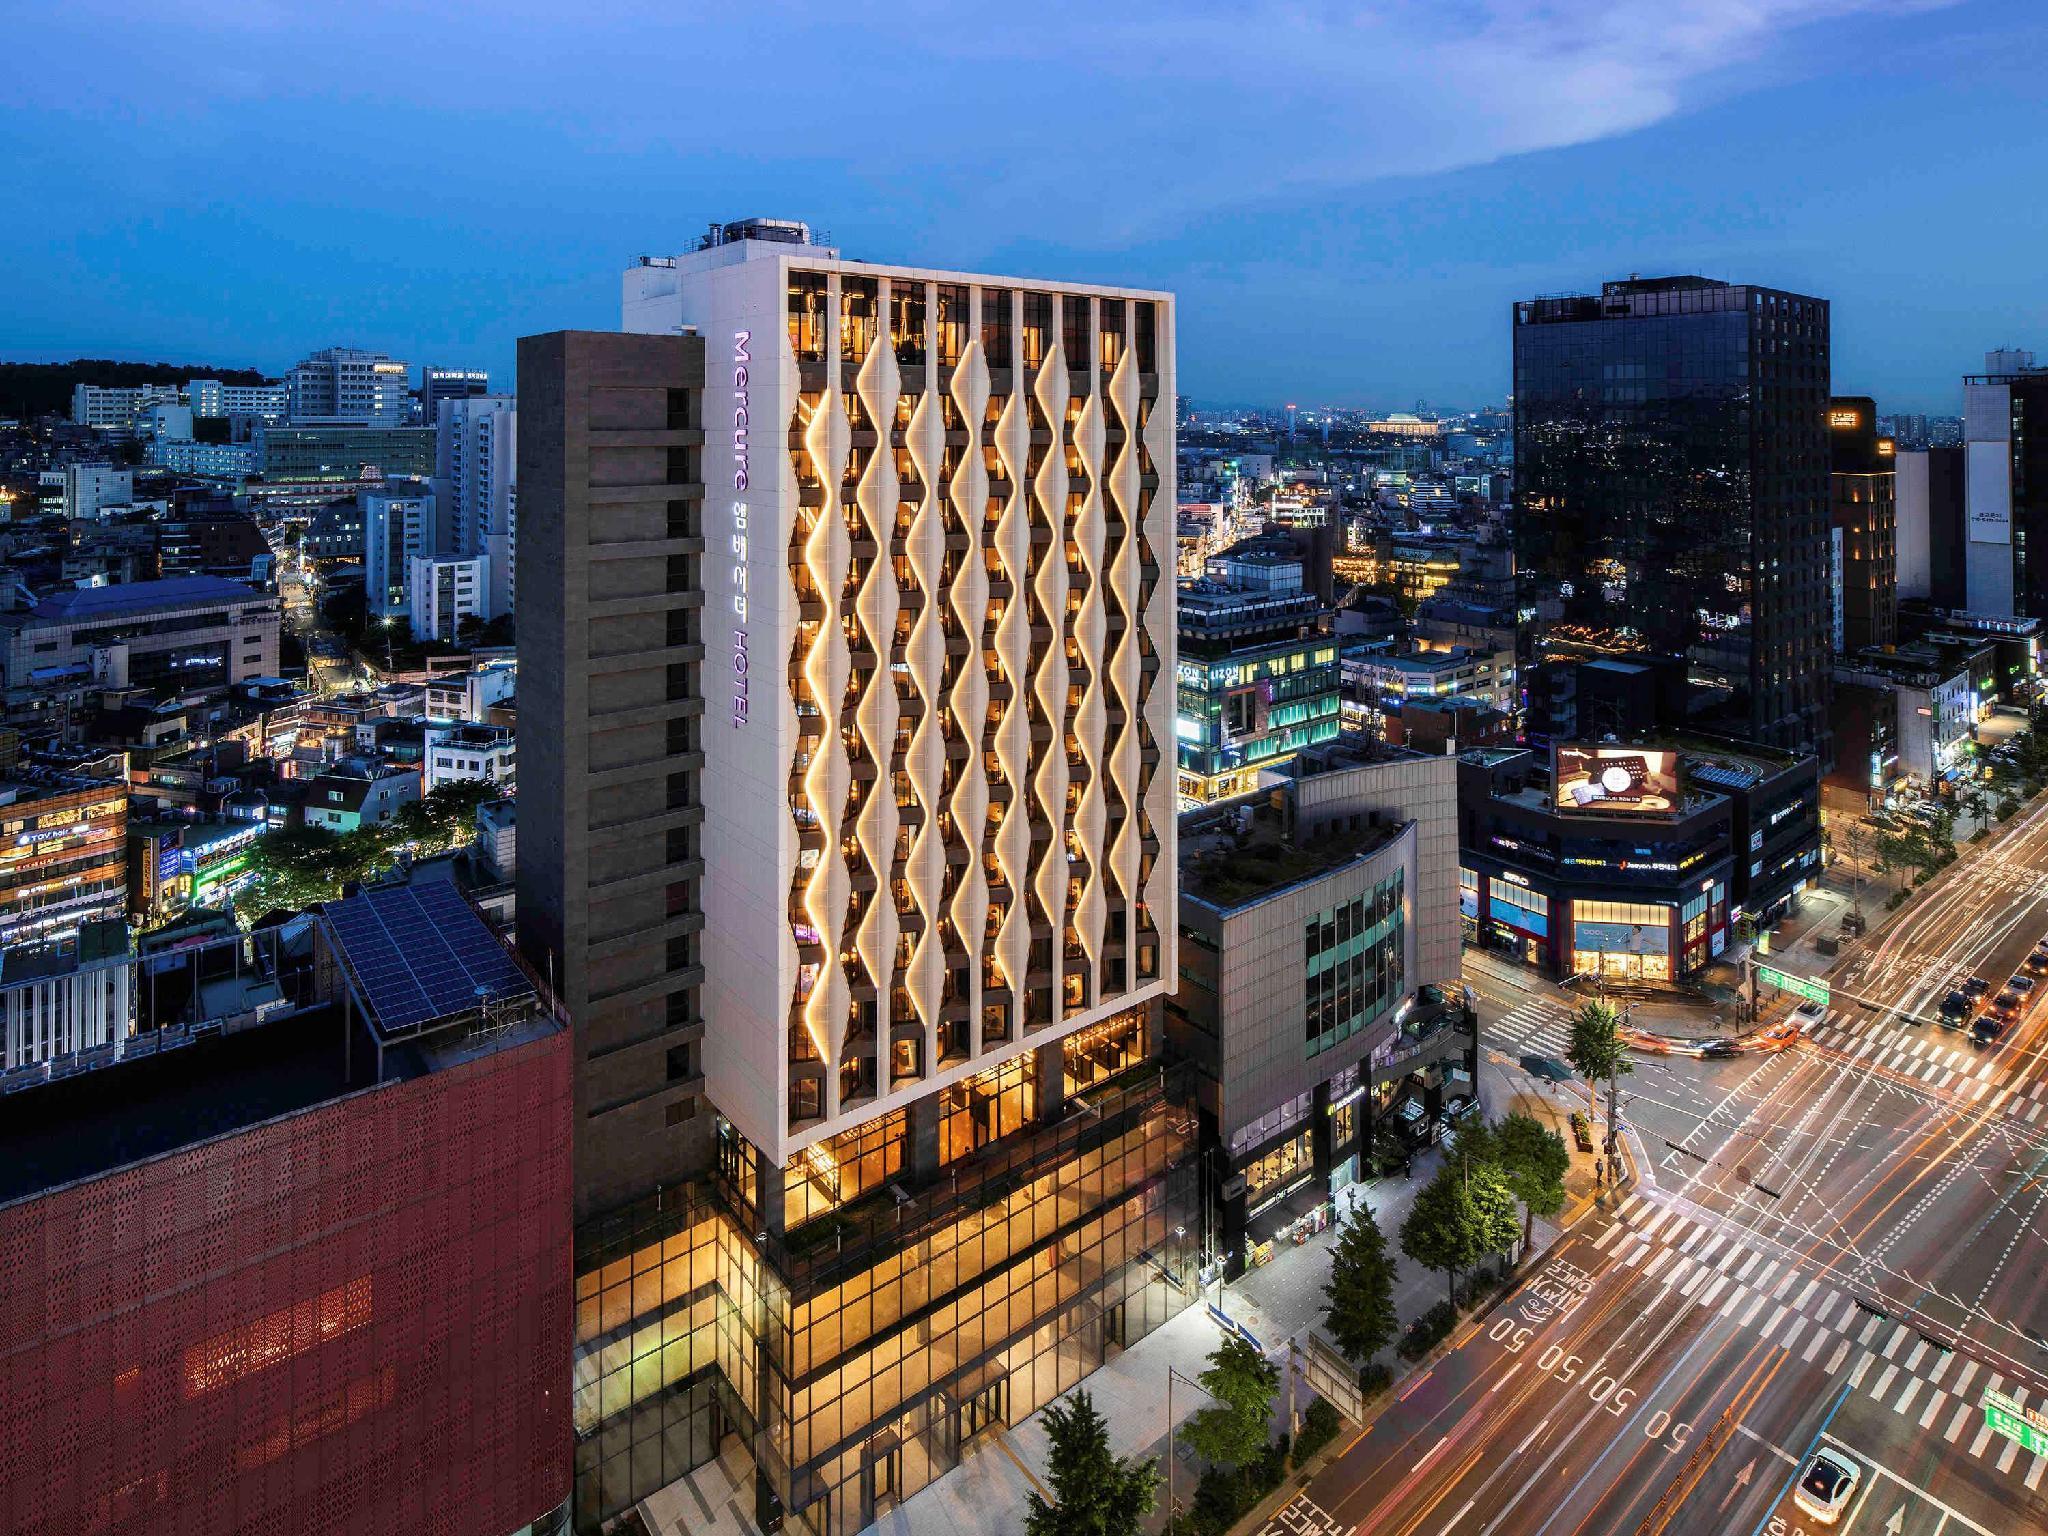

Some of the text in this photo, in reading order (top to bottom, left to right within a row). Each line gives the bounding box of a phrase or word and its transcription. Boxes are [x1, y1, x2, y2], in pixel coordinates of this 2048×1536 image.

[733, 331, 751, 730] Mercure 앰배서더 HOTEL
[1489, 1318, 1534, 1353] 50
[1537, 1345, 1583, 1383] 50
[1588, 1376, 1637, 1417] 50
[1645, 1410, 1694, 1454] 50
